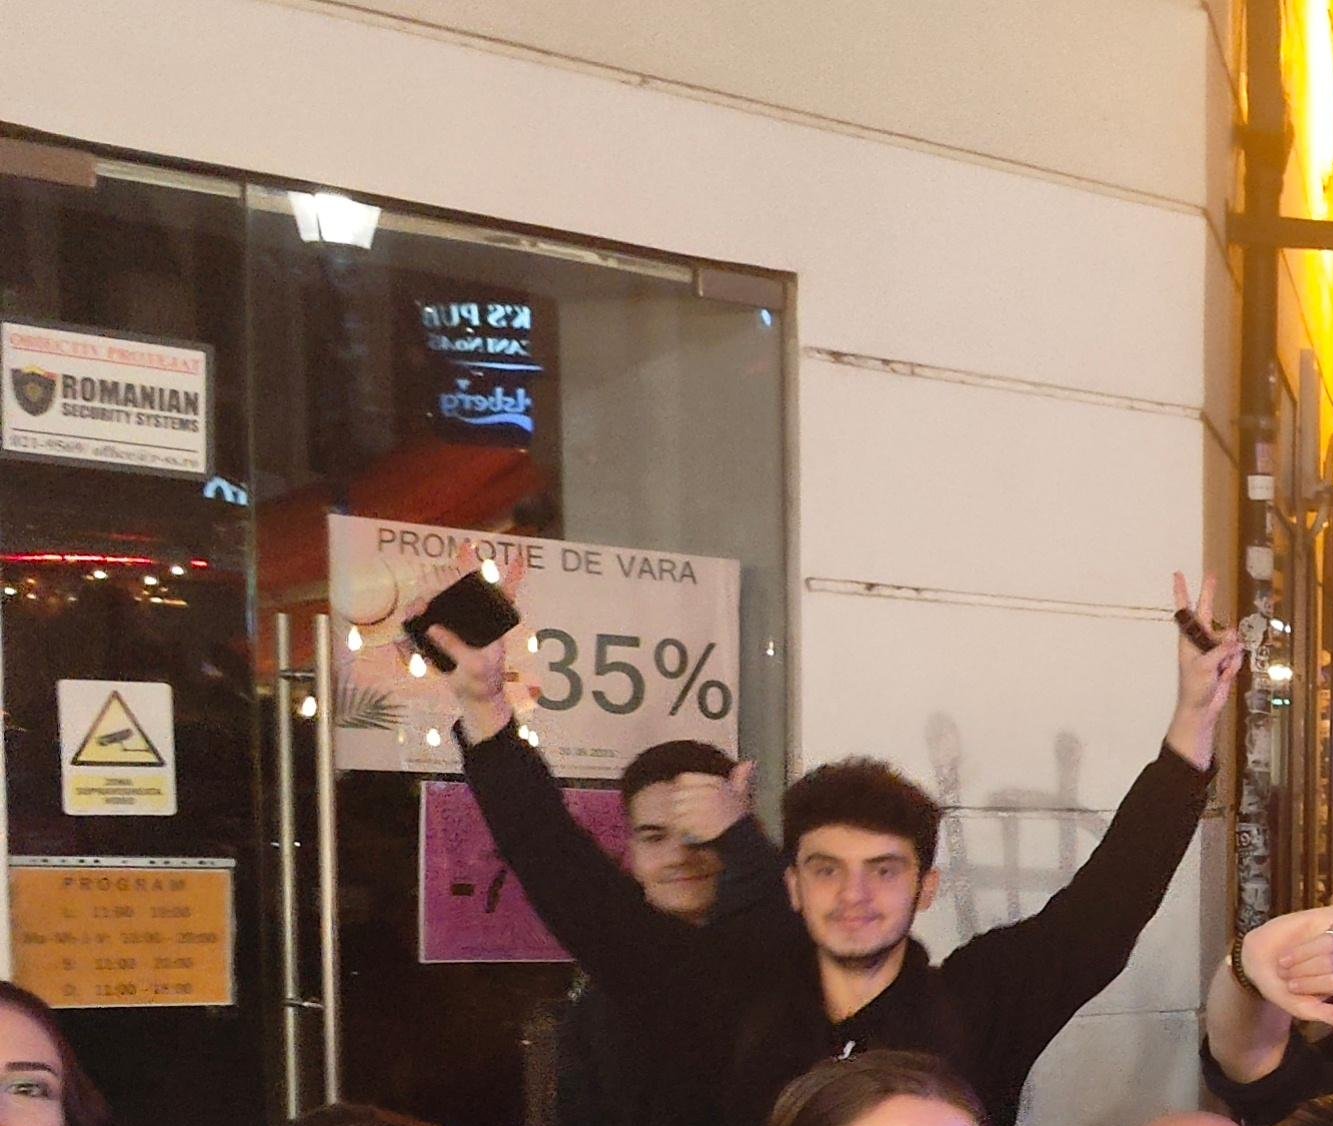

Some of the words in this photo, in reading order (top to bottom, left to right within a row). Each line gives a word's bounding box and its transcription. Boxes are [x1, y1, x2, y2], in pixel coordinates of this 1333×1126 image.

[61, 373, 200, 416] ROMANIAN
[62, 402, 131, 424] SECURITY
[136, 412, 200, 433] SYSTEMS
[561, 548, 603, 575] DE
[616, 555, 698, 584] VARA
